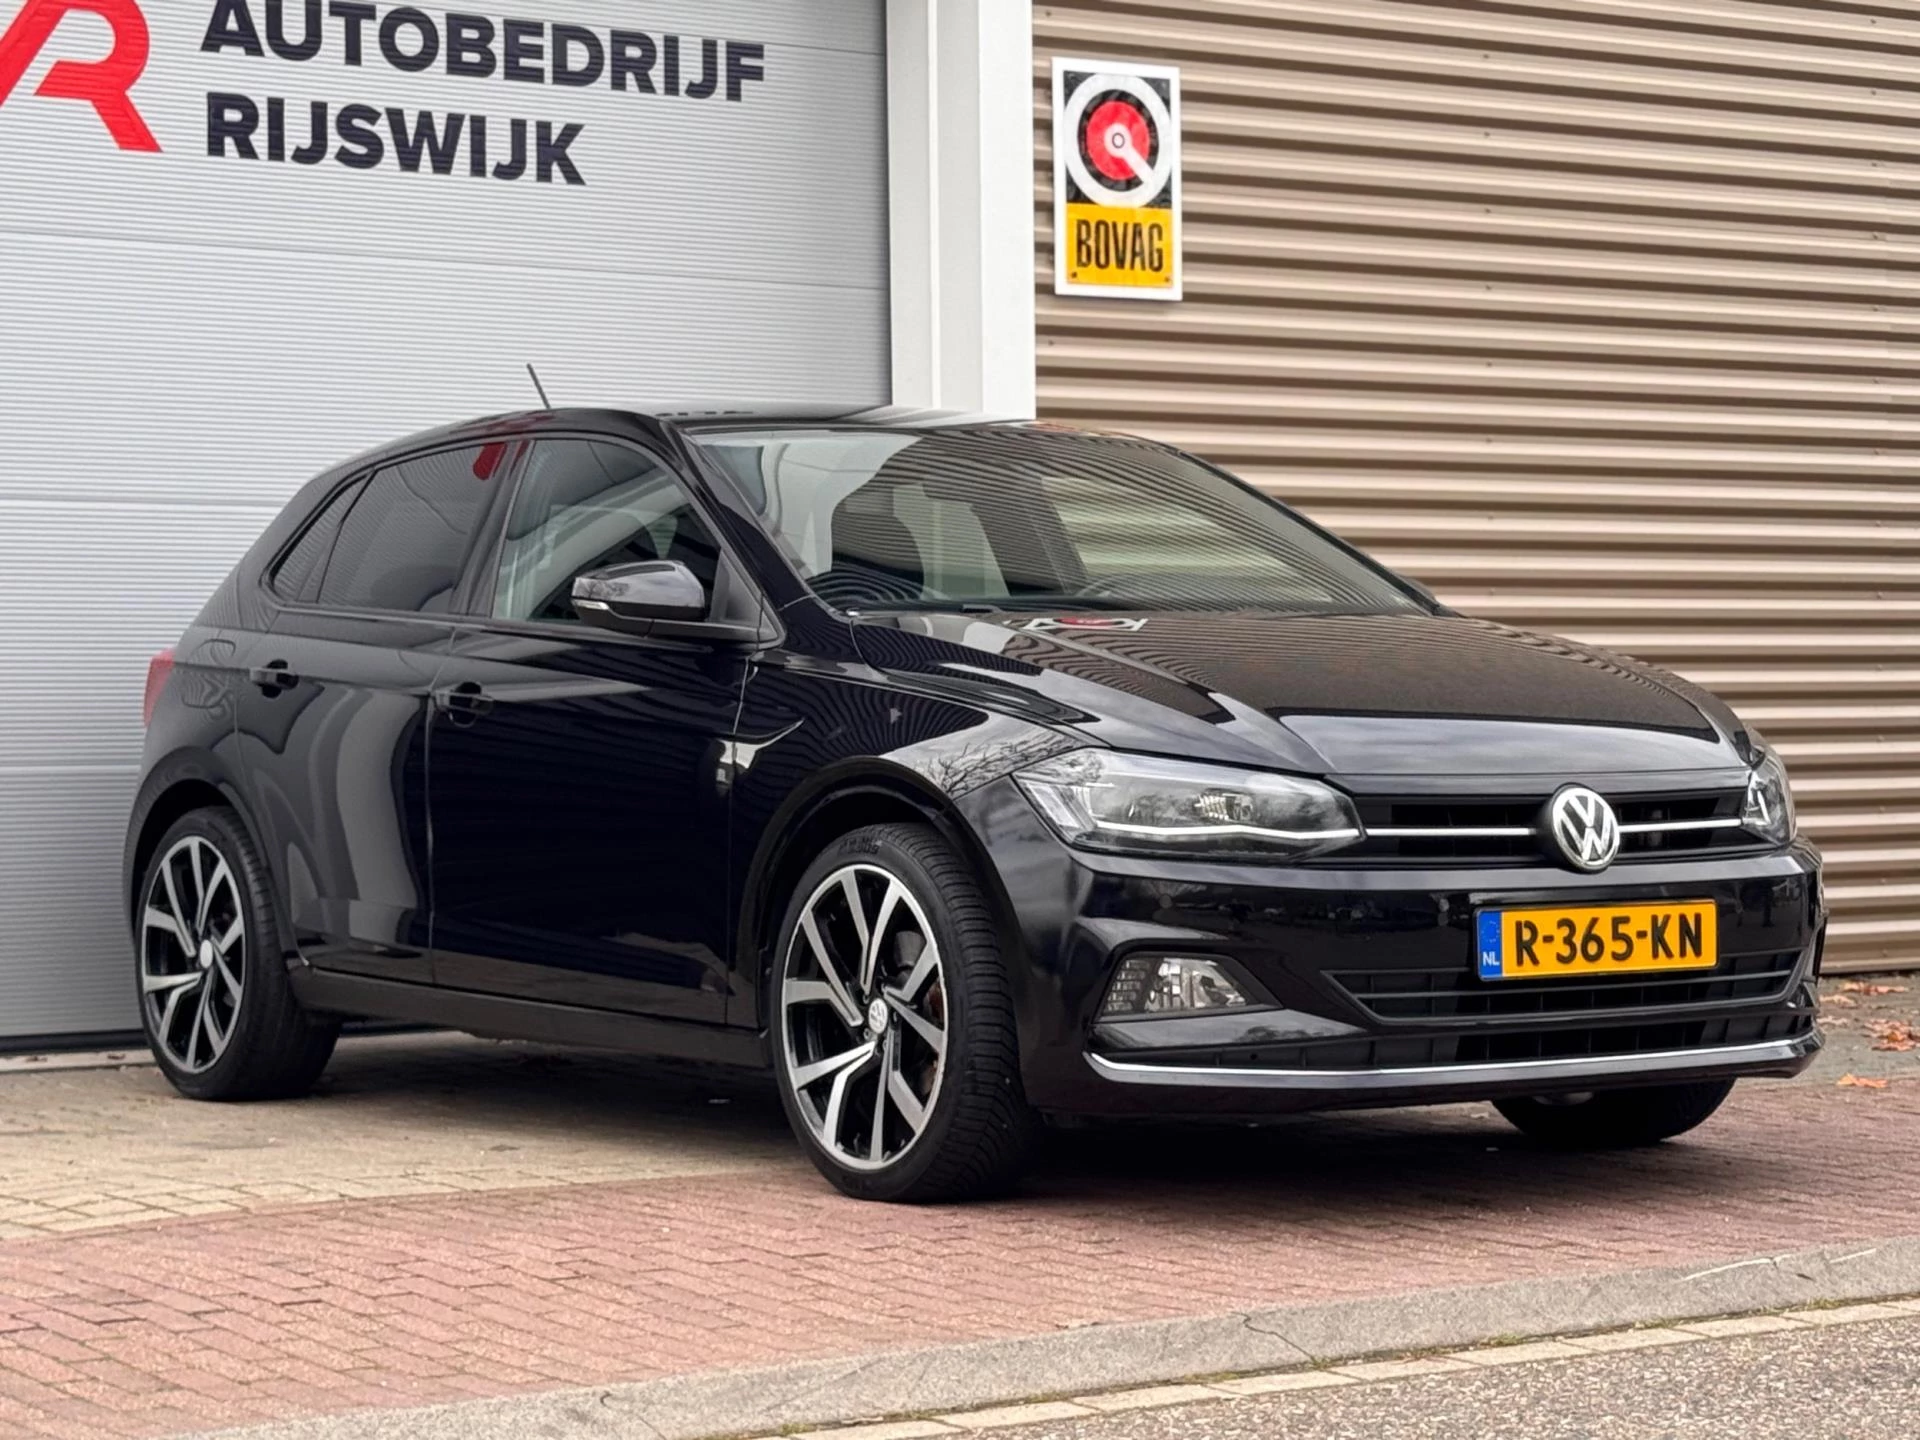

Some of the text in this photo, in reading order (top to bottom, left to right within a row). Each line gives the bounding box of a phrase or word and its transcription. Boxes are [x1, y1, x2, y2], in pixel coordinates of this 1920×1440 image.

[201, 0, 765, 102] AUTOBEDRIJF
[206, 91, 587, 186] RIJSWIJK
[1075, 218, 1164, 273] BOVAG
[1482, 951, 1501, 968] NL
[1514, 911, 1703, 968] R-365-KN
